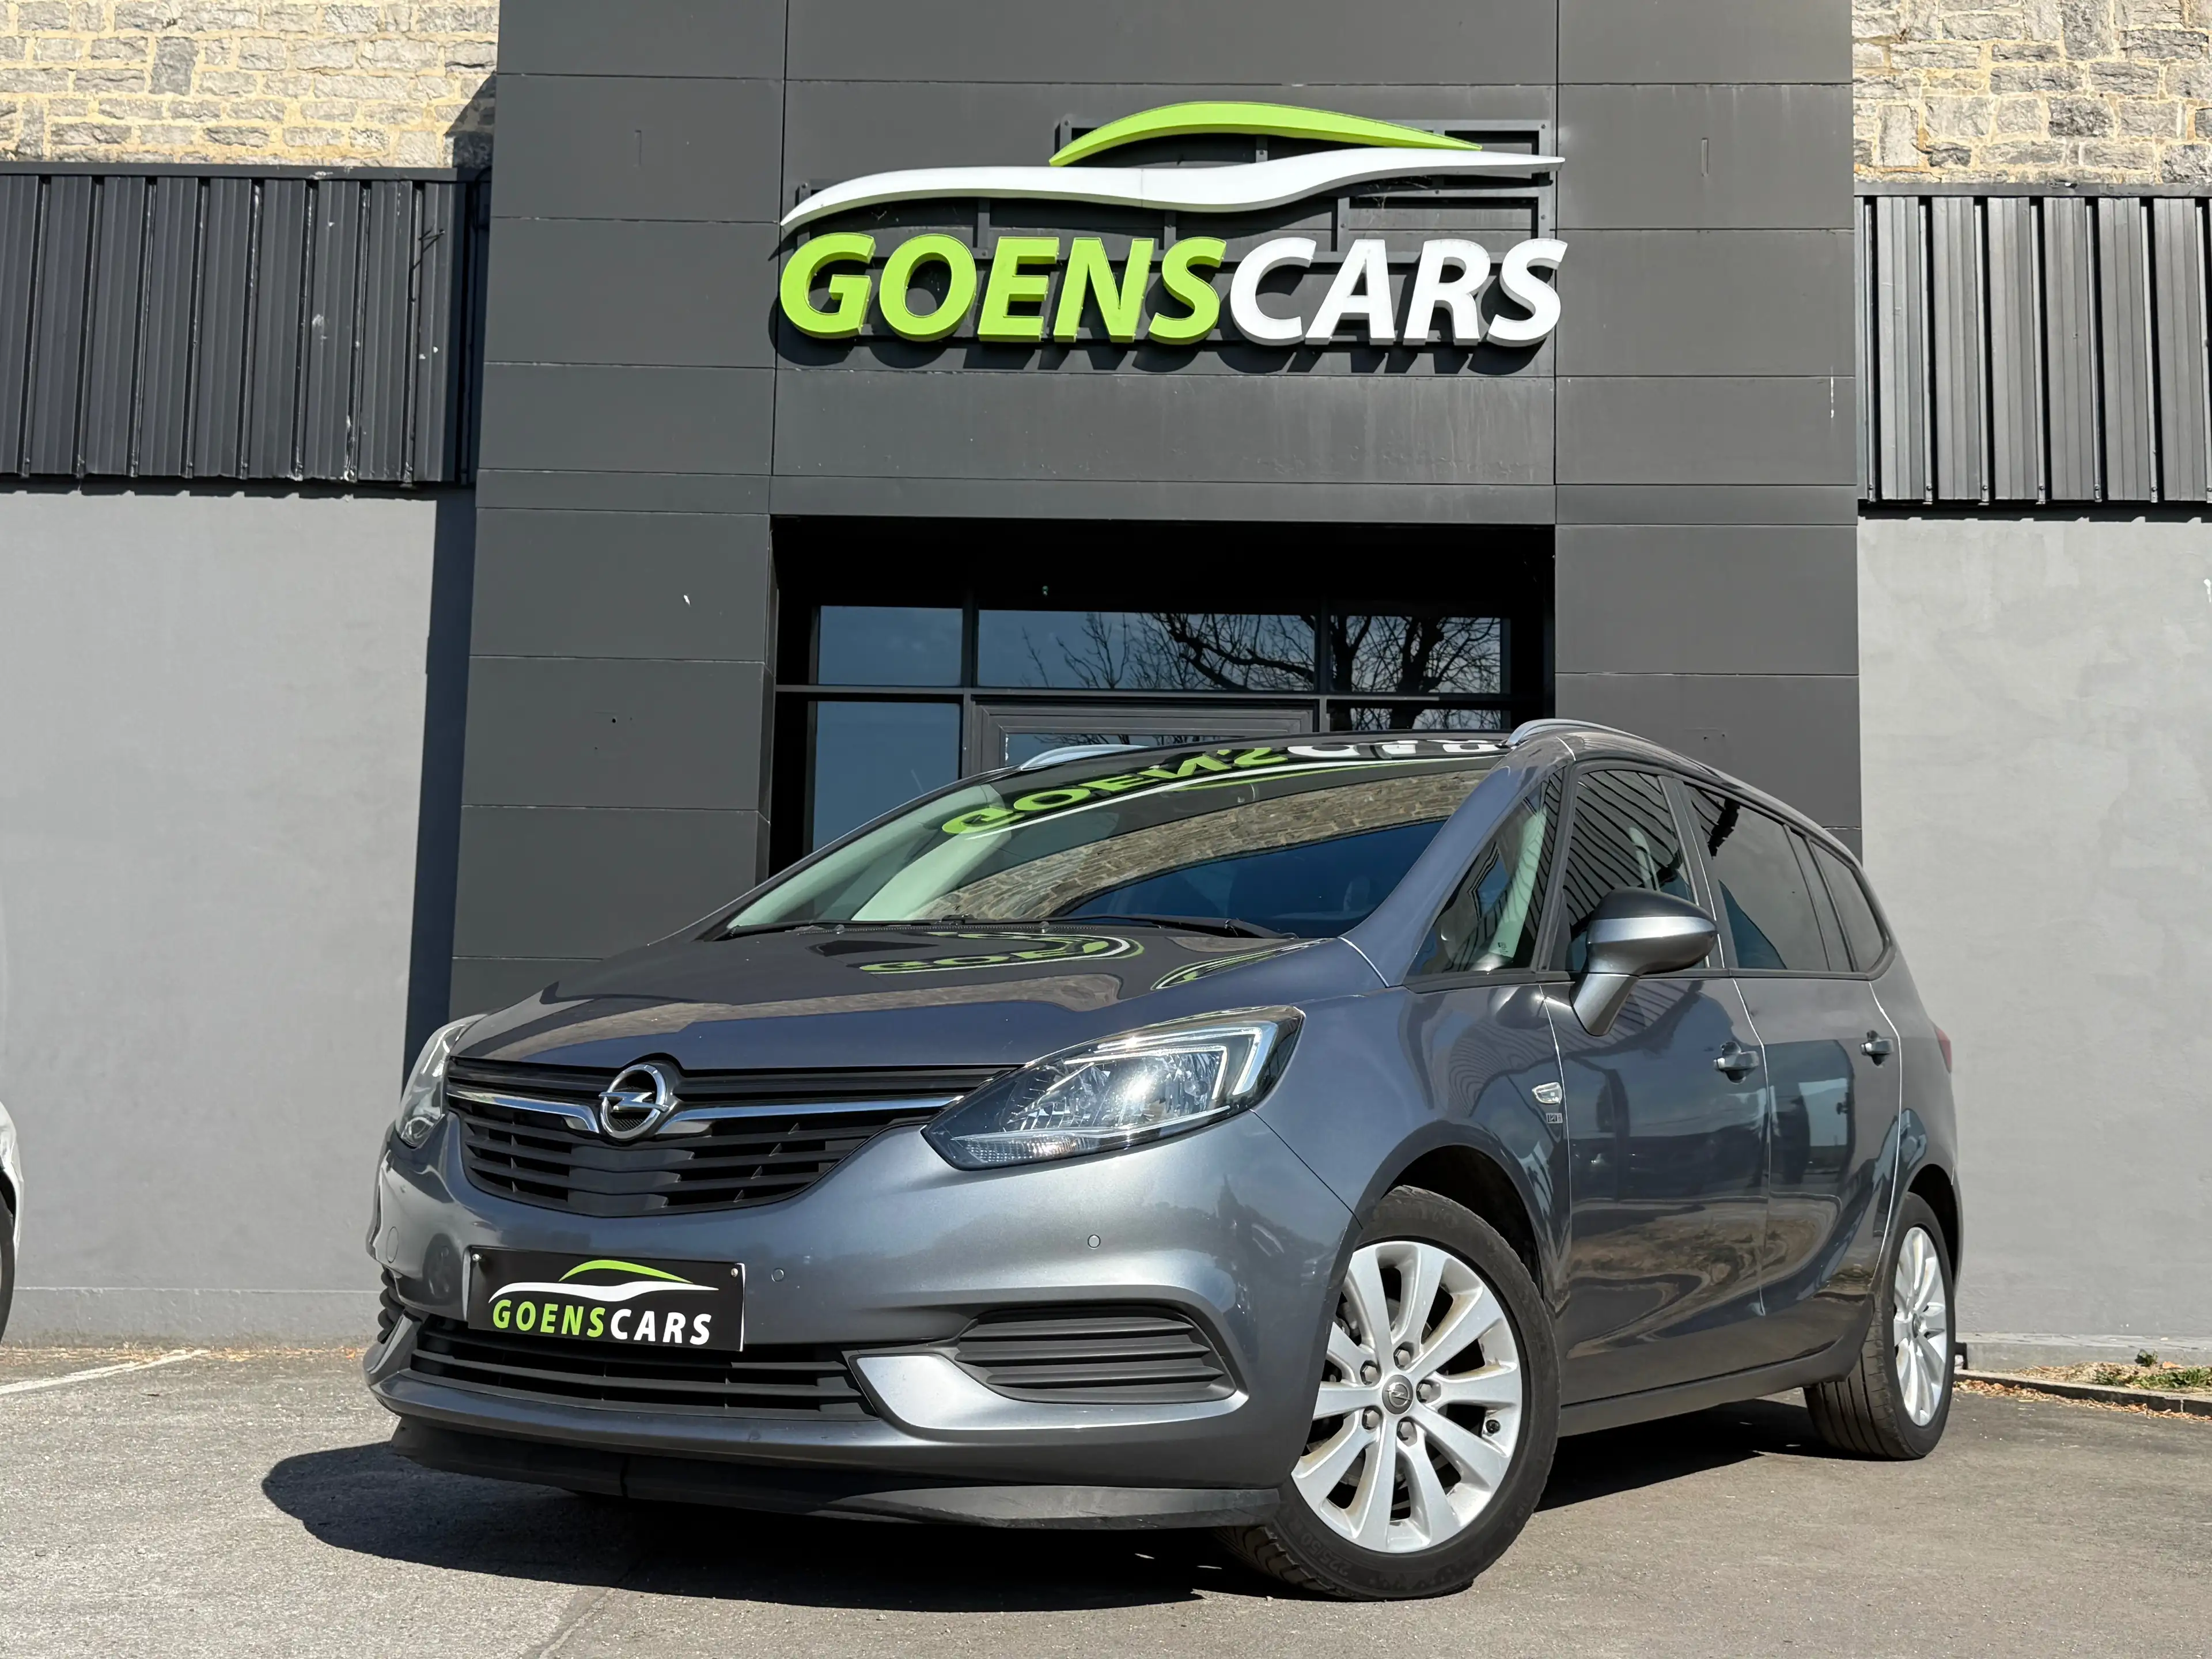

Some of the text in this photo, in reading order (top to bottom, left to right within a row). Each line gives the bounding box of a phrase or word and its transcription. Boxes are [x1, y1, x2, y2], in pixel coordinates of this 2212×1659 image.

[780, 232, 1568, 347] GOENSCARS
[493, 1299, 712, 1346] GOENSCARS
[1300, 1532, 1353, 1577] 225/50
